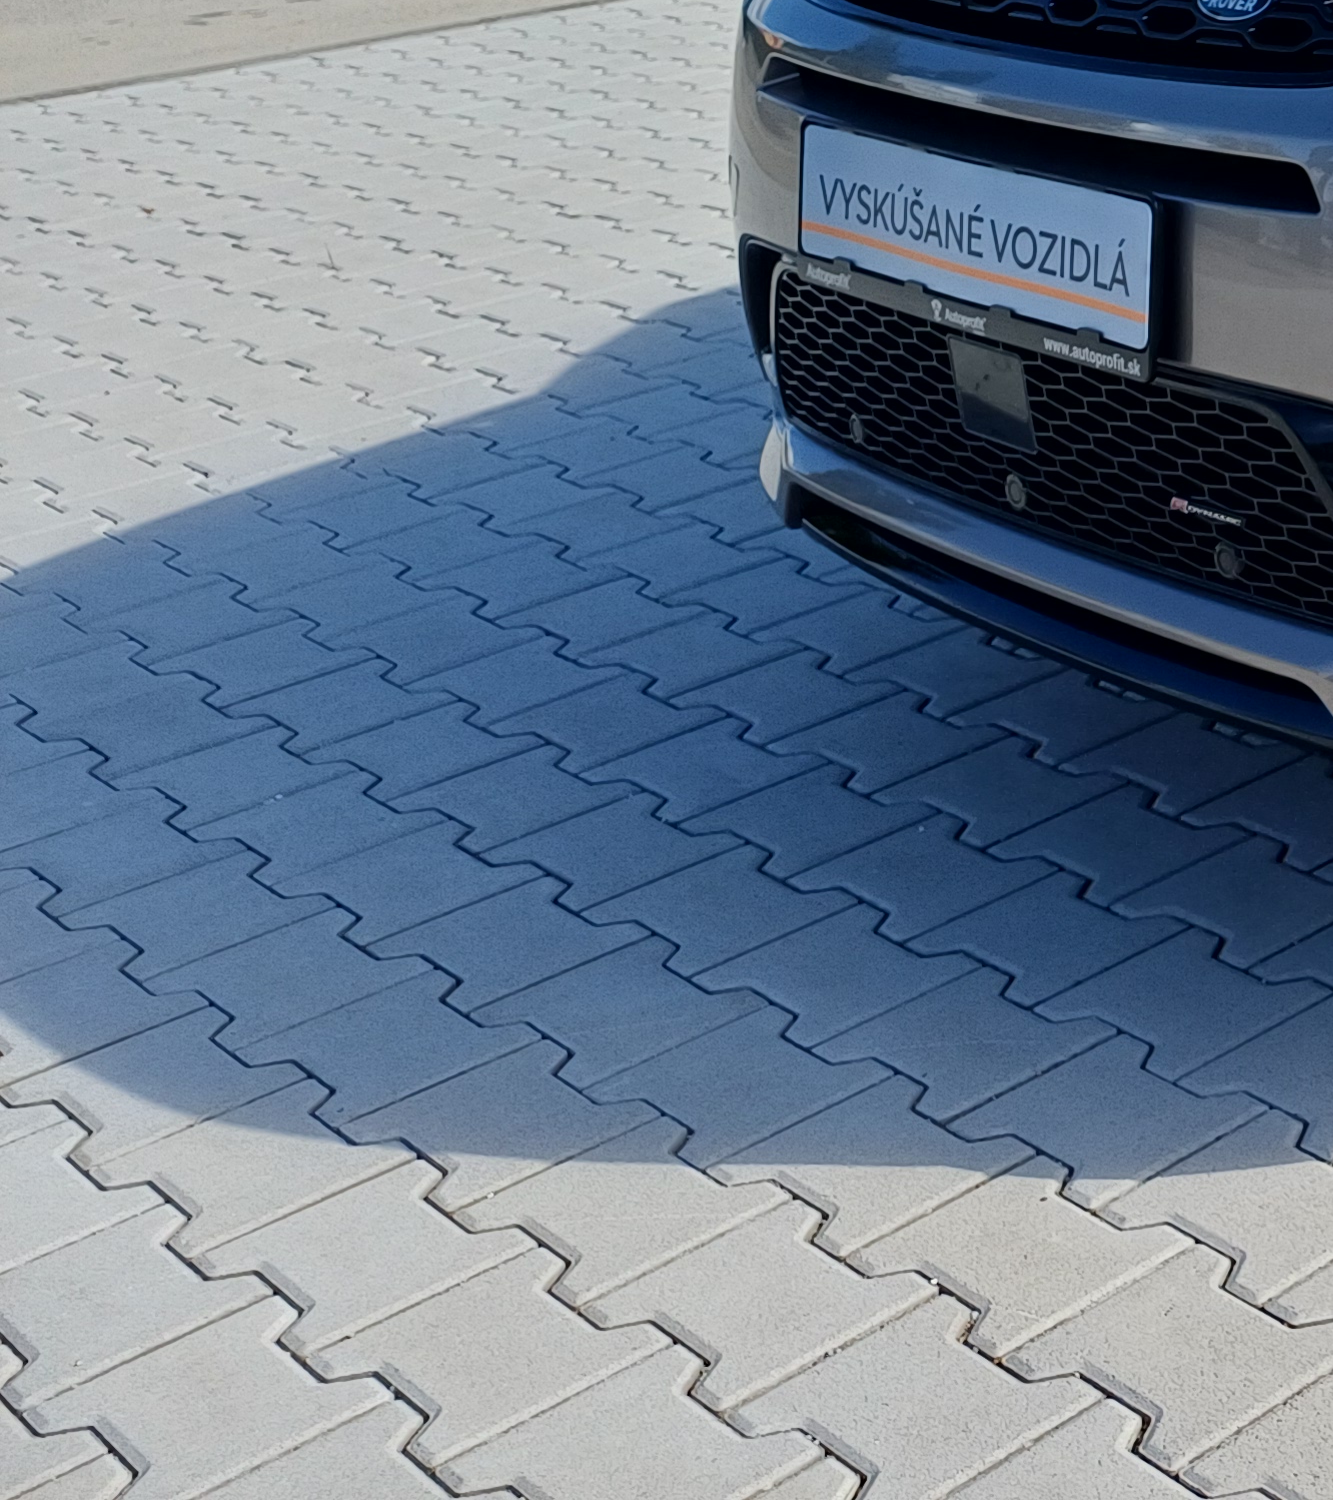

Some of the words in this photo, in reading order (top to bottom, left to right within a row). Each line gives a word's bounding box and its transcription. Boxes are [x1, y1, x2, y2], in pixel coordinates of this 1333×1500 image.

[819, 174, 984, 258] VYSKÚŠANÉ
[990, 218, 1130, 297] VOZIDLÁ
[1043, 337, 1141, 378] www.autoprofit.sk
